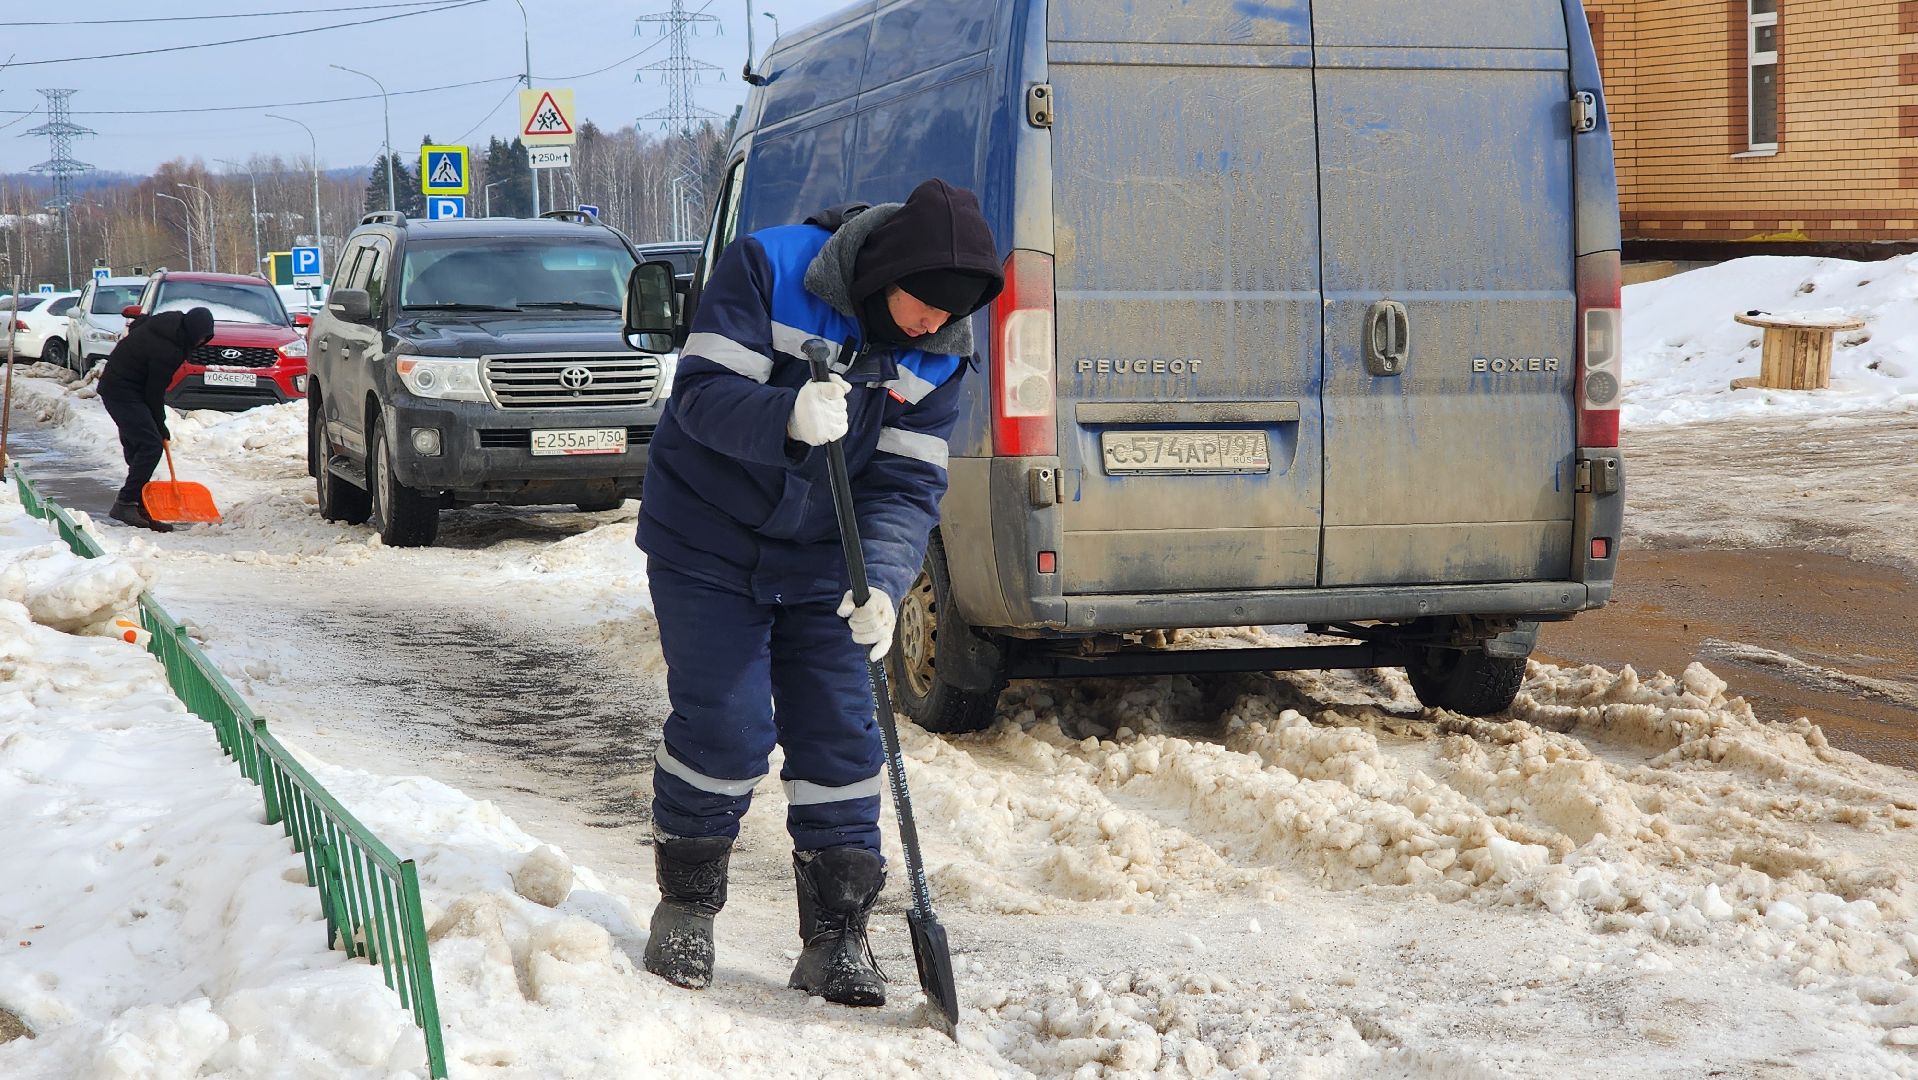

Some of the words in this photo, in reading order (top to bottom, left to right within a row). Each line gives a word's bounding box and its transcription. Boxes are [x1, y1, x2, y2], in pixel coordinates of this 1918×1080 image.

[437, 200, 459, 220] P
[299, 250, 316, 272] P
[1077, 359, 1202, 375] PEUGEOT
[1472, 358, 1559, 373] BOXER
[599, 430, 621, 443] 750
[1221, 435, 1259, 456] 797
[1233, 456, 1252, 464] RUS
